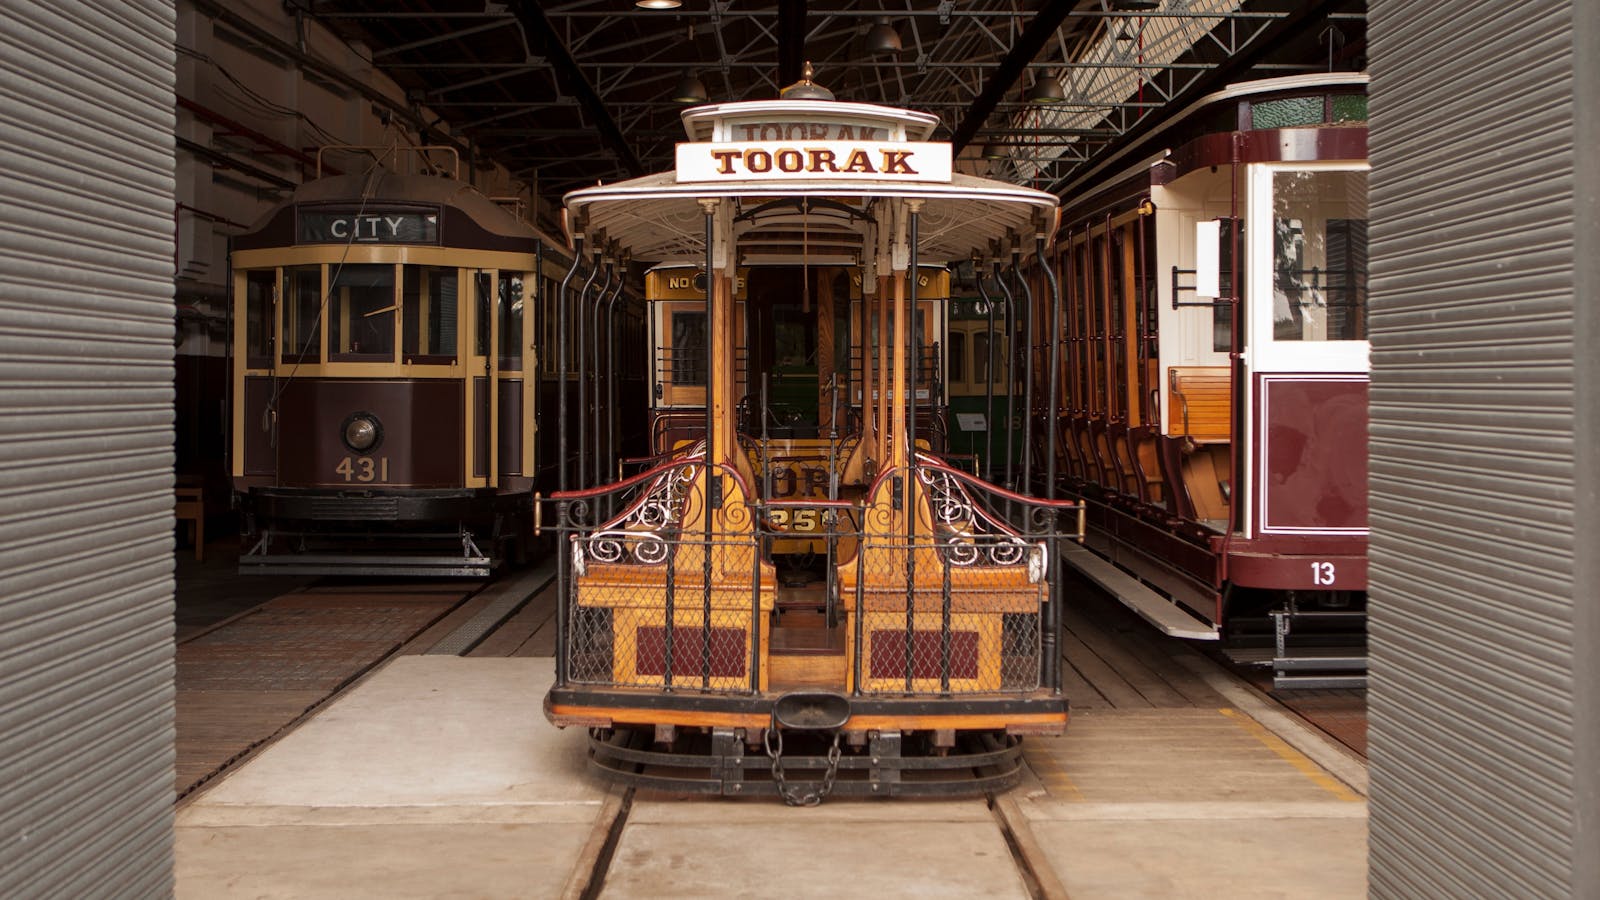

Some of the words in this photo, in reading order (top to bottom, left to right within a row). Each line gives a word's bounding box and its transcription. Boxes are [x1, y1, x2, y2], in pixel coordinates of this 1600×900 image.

[711, 147, 919, 175] TOORAK
[330, 216, 404, 238] CITY
[669, 276, 690, 289] NO
[335, 456, 388, 482] 431
[1310, 561, 1336, 586] 13
